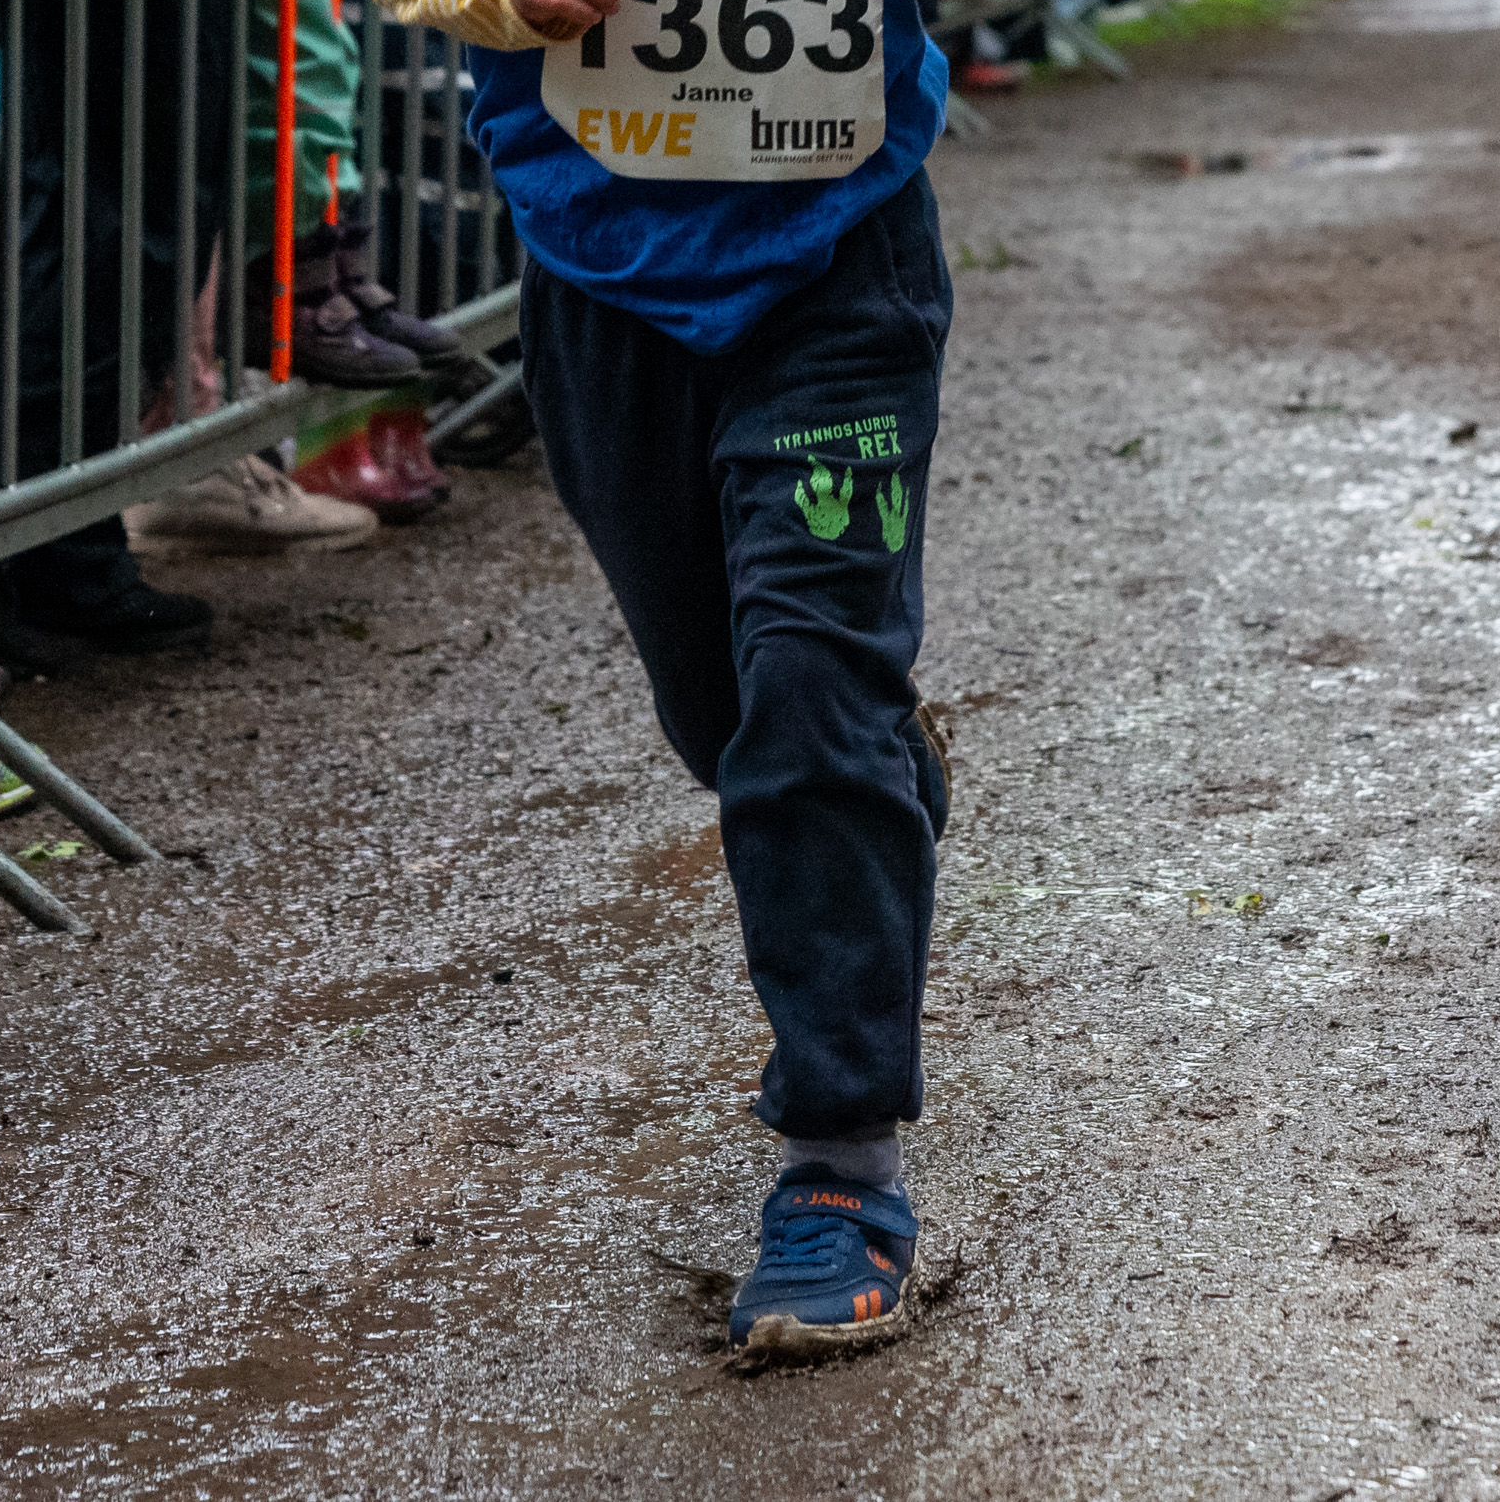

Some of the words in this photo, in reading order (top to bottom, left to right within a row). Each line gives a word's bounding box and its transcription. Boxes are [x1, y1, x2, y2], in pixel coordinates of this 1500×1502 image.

[671, 83, 754, 102] Janne
[576, 108, 697, 157] EWE
[751, 108, 856, 150] bruns
[773, 414, 897, 451] TYRANNOSAURUS
[858, 431, 902, 460] REX
[808, 1191, 862, 1211] JAKO
